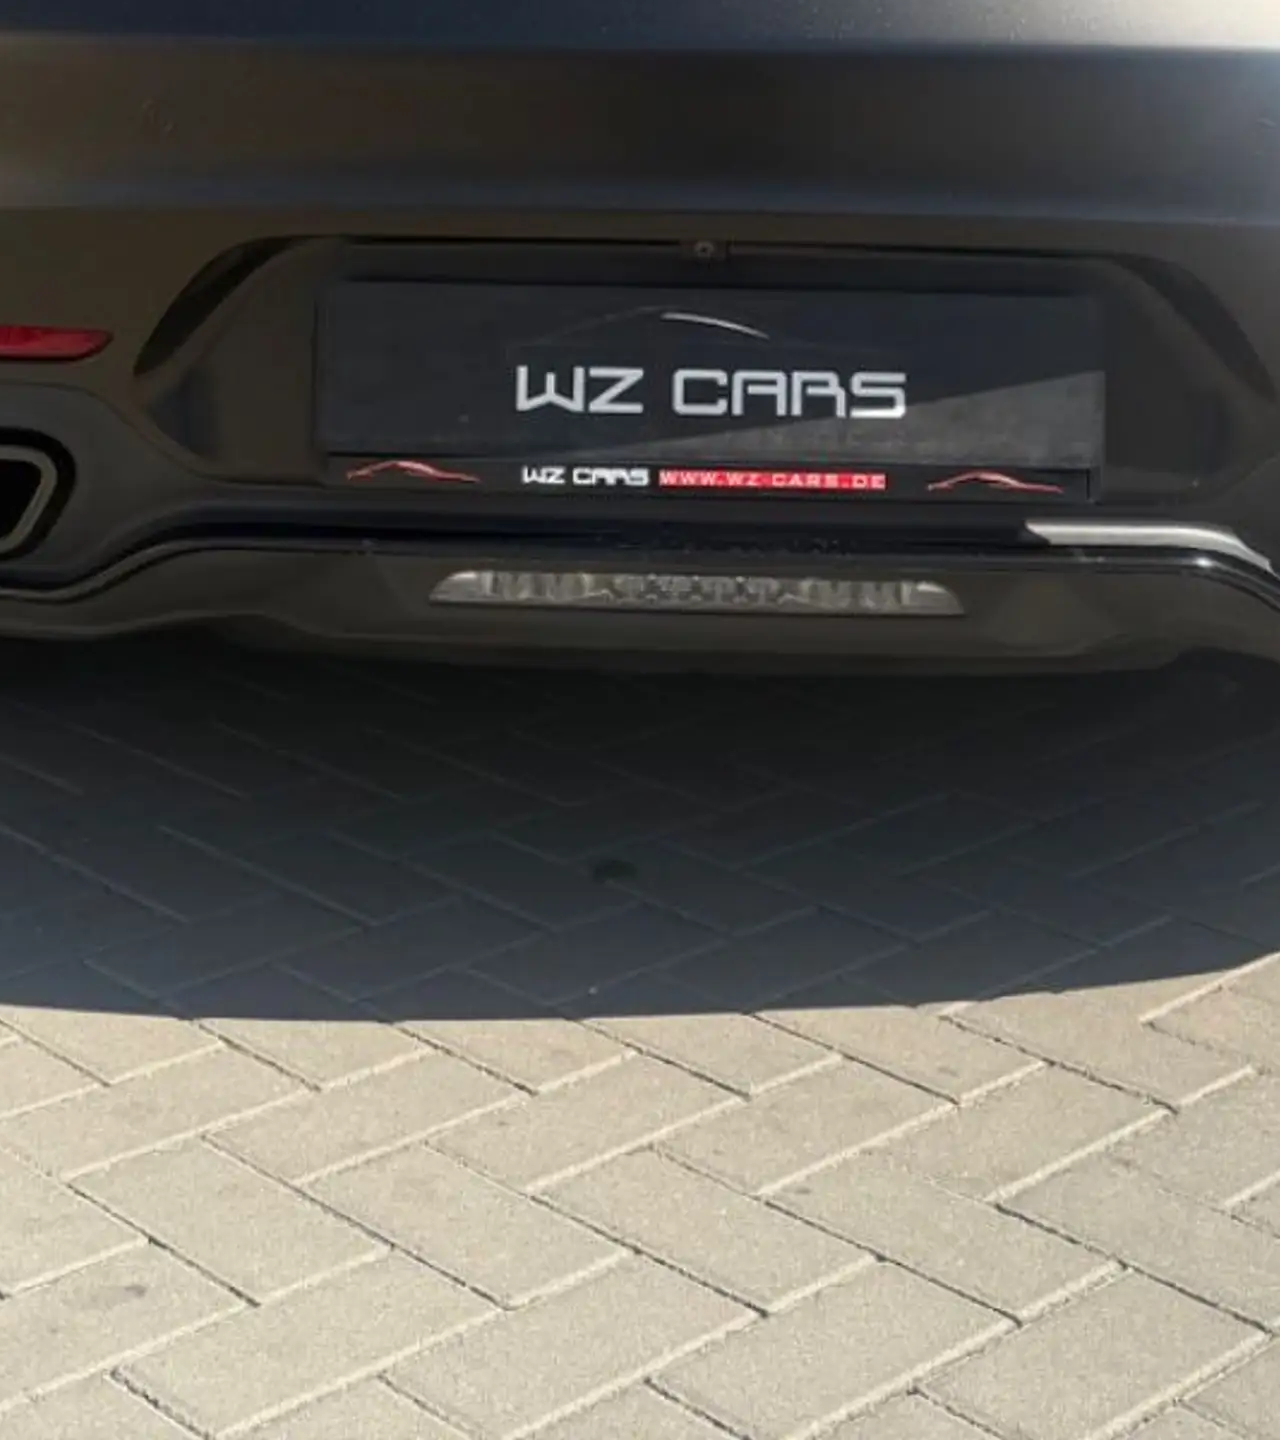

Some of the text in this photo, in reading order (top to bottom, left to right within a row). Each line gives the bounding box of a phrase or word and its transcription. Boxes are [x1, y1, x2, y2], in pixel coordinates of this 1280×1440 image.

[516, 364, 908, 420] WZ CARS
[521, 465, 886, 490] WZ CARS WWW.WZ-CARS.DE
